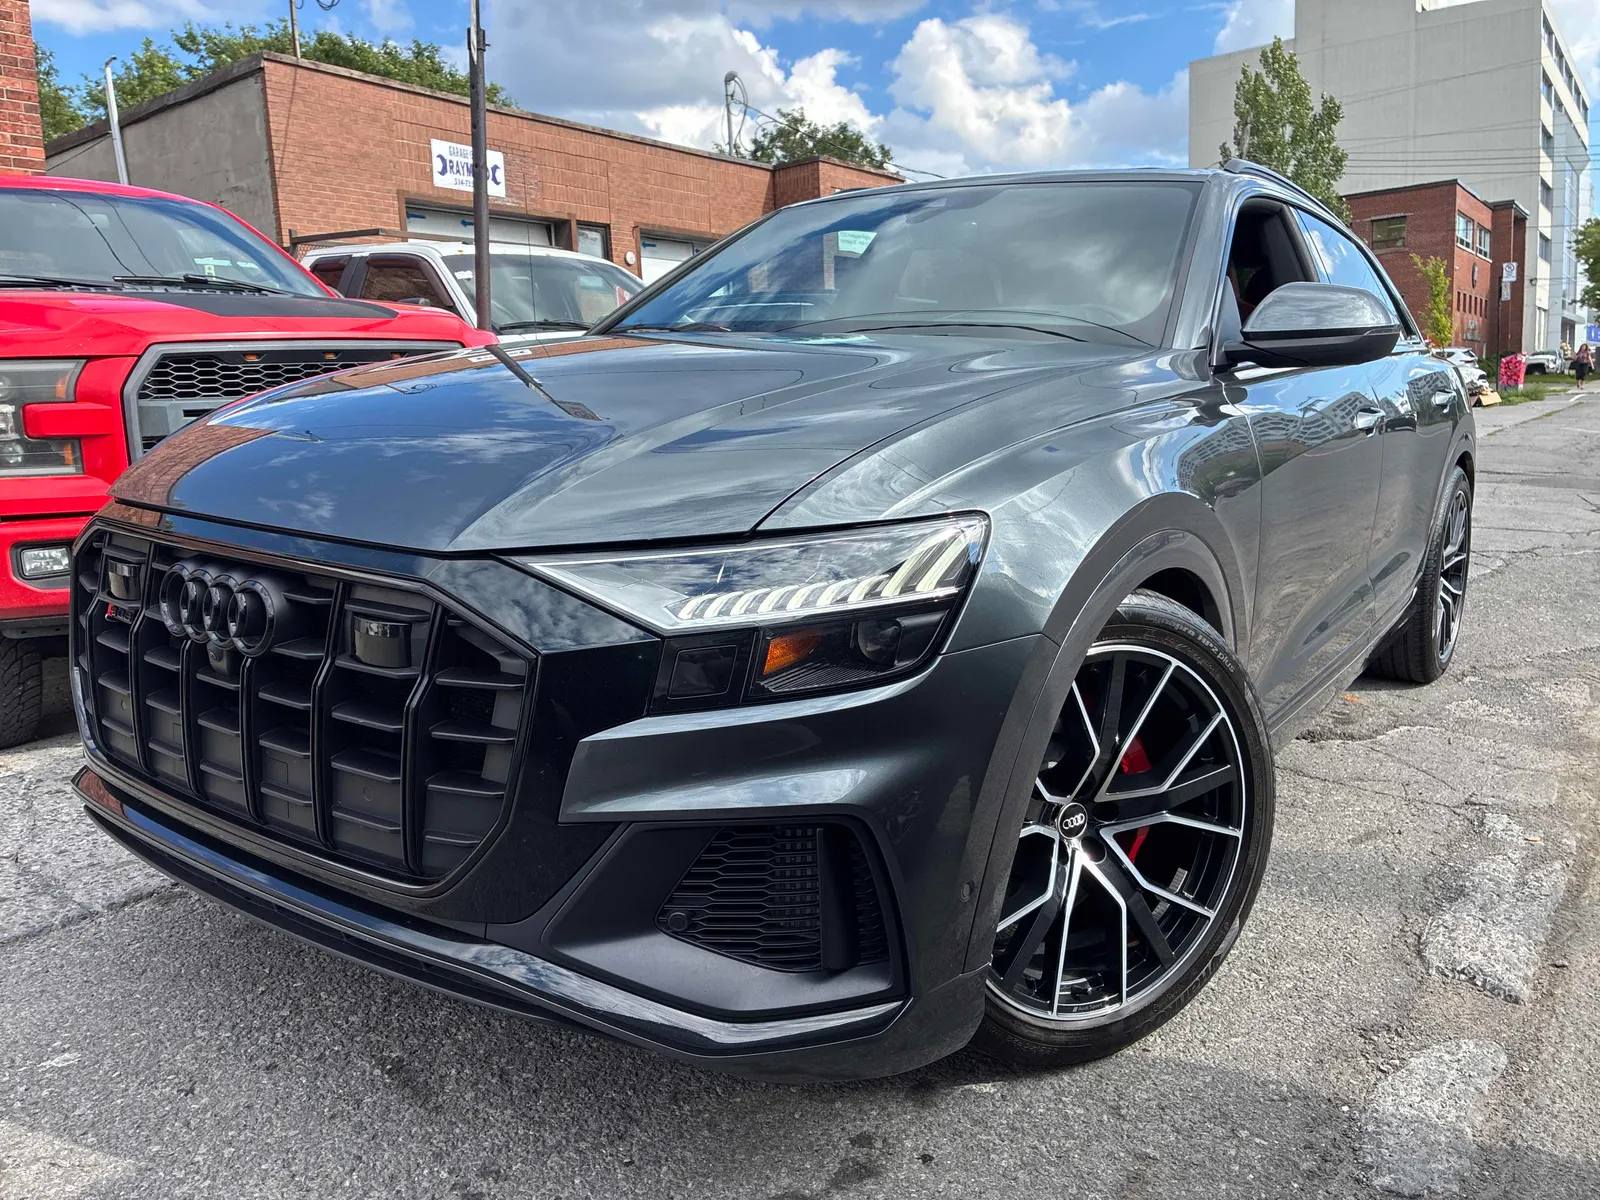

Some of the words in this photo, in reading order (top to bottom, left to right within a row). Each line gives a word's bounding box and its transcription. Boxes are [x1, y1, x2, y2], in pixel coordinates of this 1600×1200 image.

[449, 146, 468, 158] GARAGE
[449, 159, 490, 181] RAYMD
[1216, 652, 1235, 673] plus
